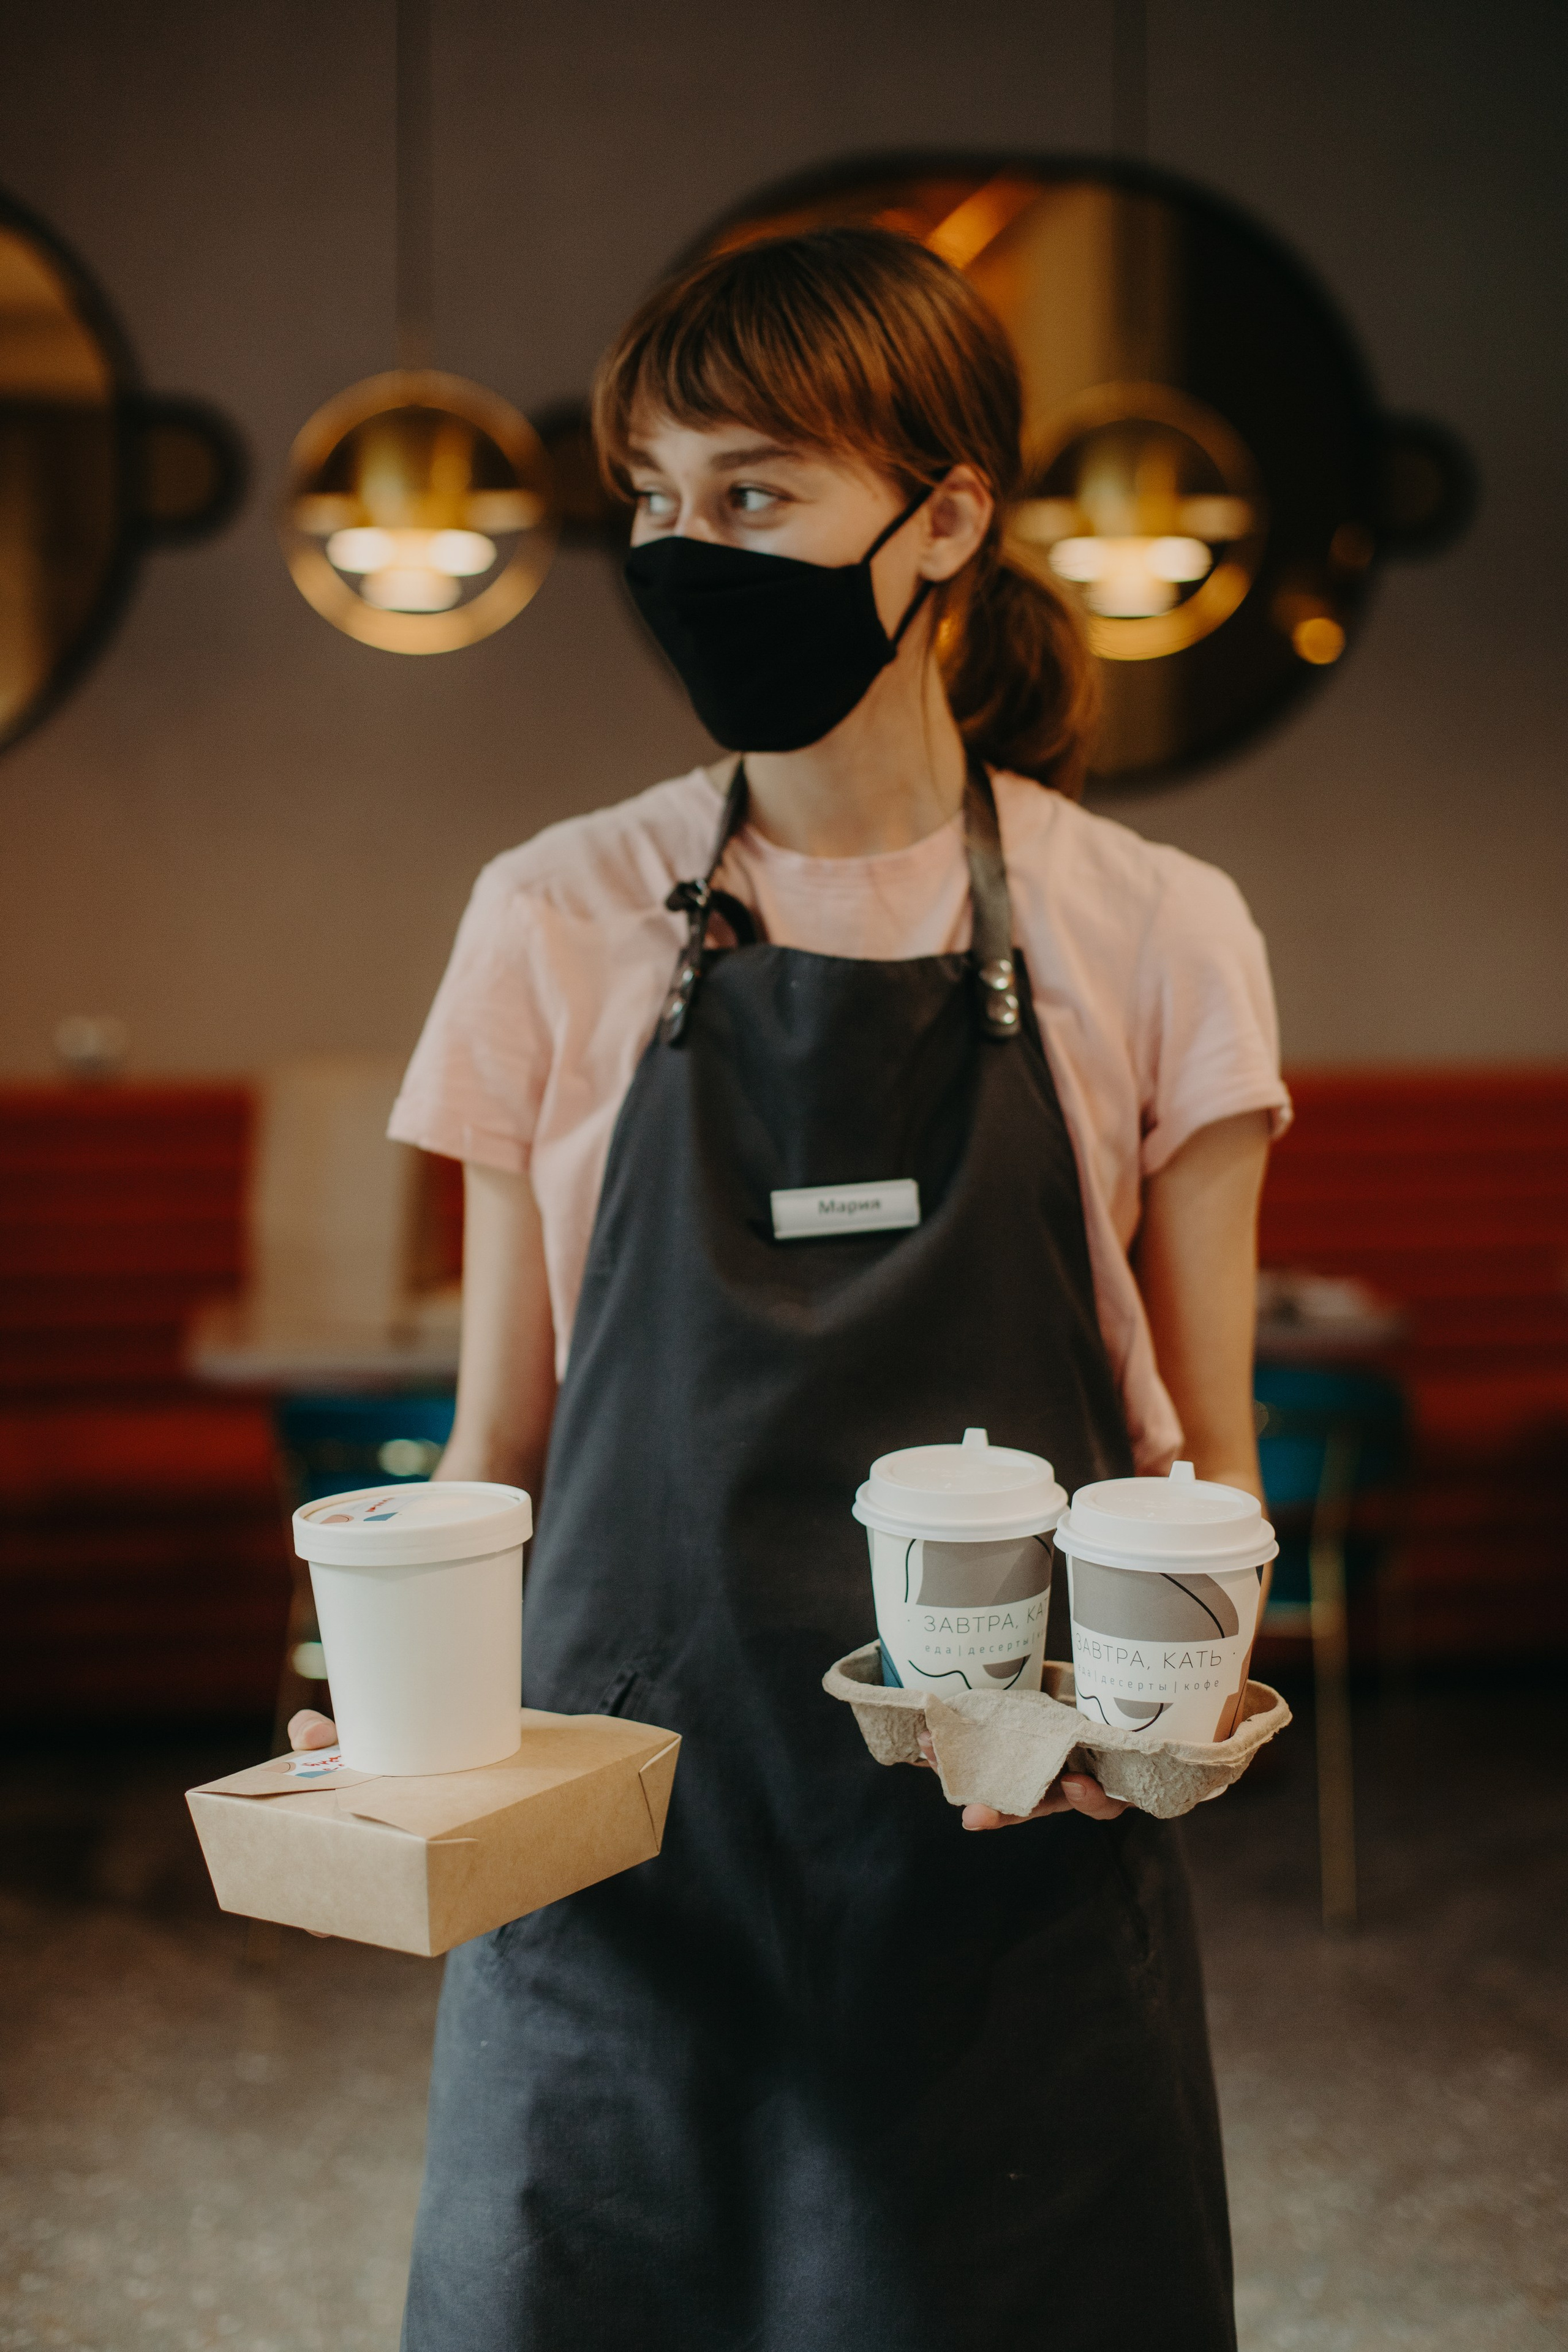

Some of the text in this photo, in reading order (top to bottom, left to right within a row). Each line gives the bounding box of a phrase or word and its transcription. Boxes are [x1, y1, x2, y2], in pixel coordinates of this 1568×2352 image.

[818, 1198, 881, 1215] Мария
[924, 1613, 1019, 1634] ЗАВТРА,
[1027, 1596, 1049, 1624] КА
[925, 1637, 1029, 1656] еда десерты
[1076, 1632, 1222, 1670] ЗАВТРА, КАТЬ
[1101, 1675, 1167, 1692] десерты
[1184, 1679, 1219, 1691] кофе
